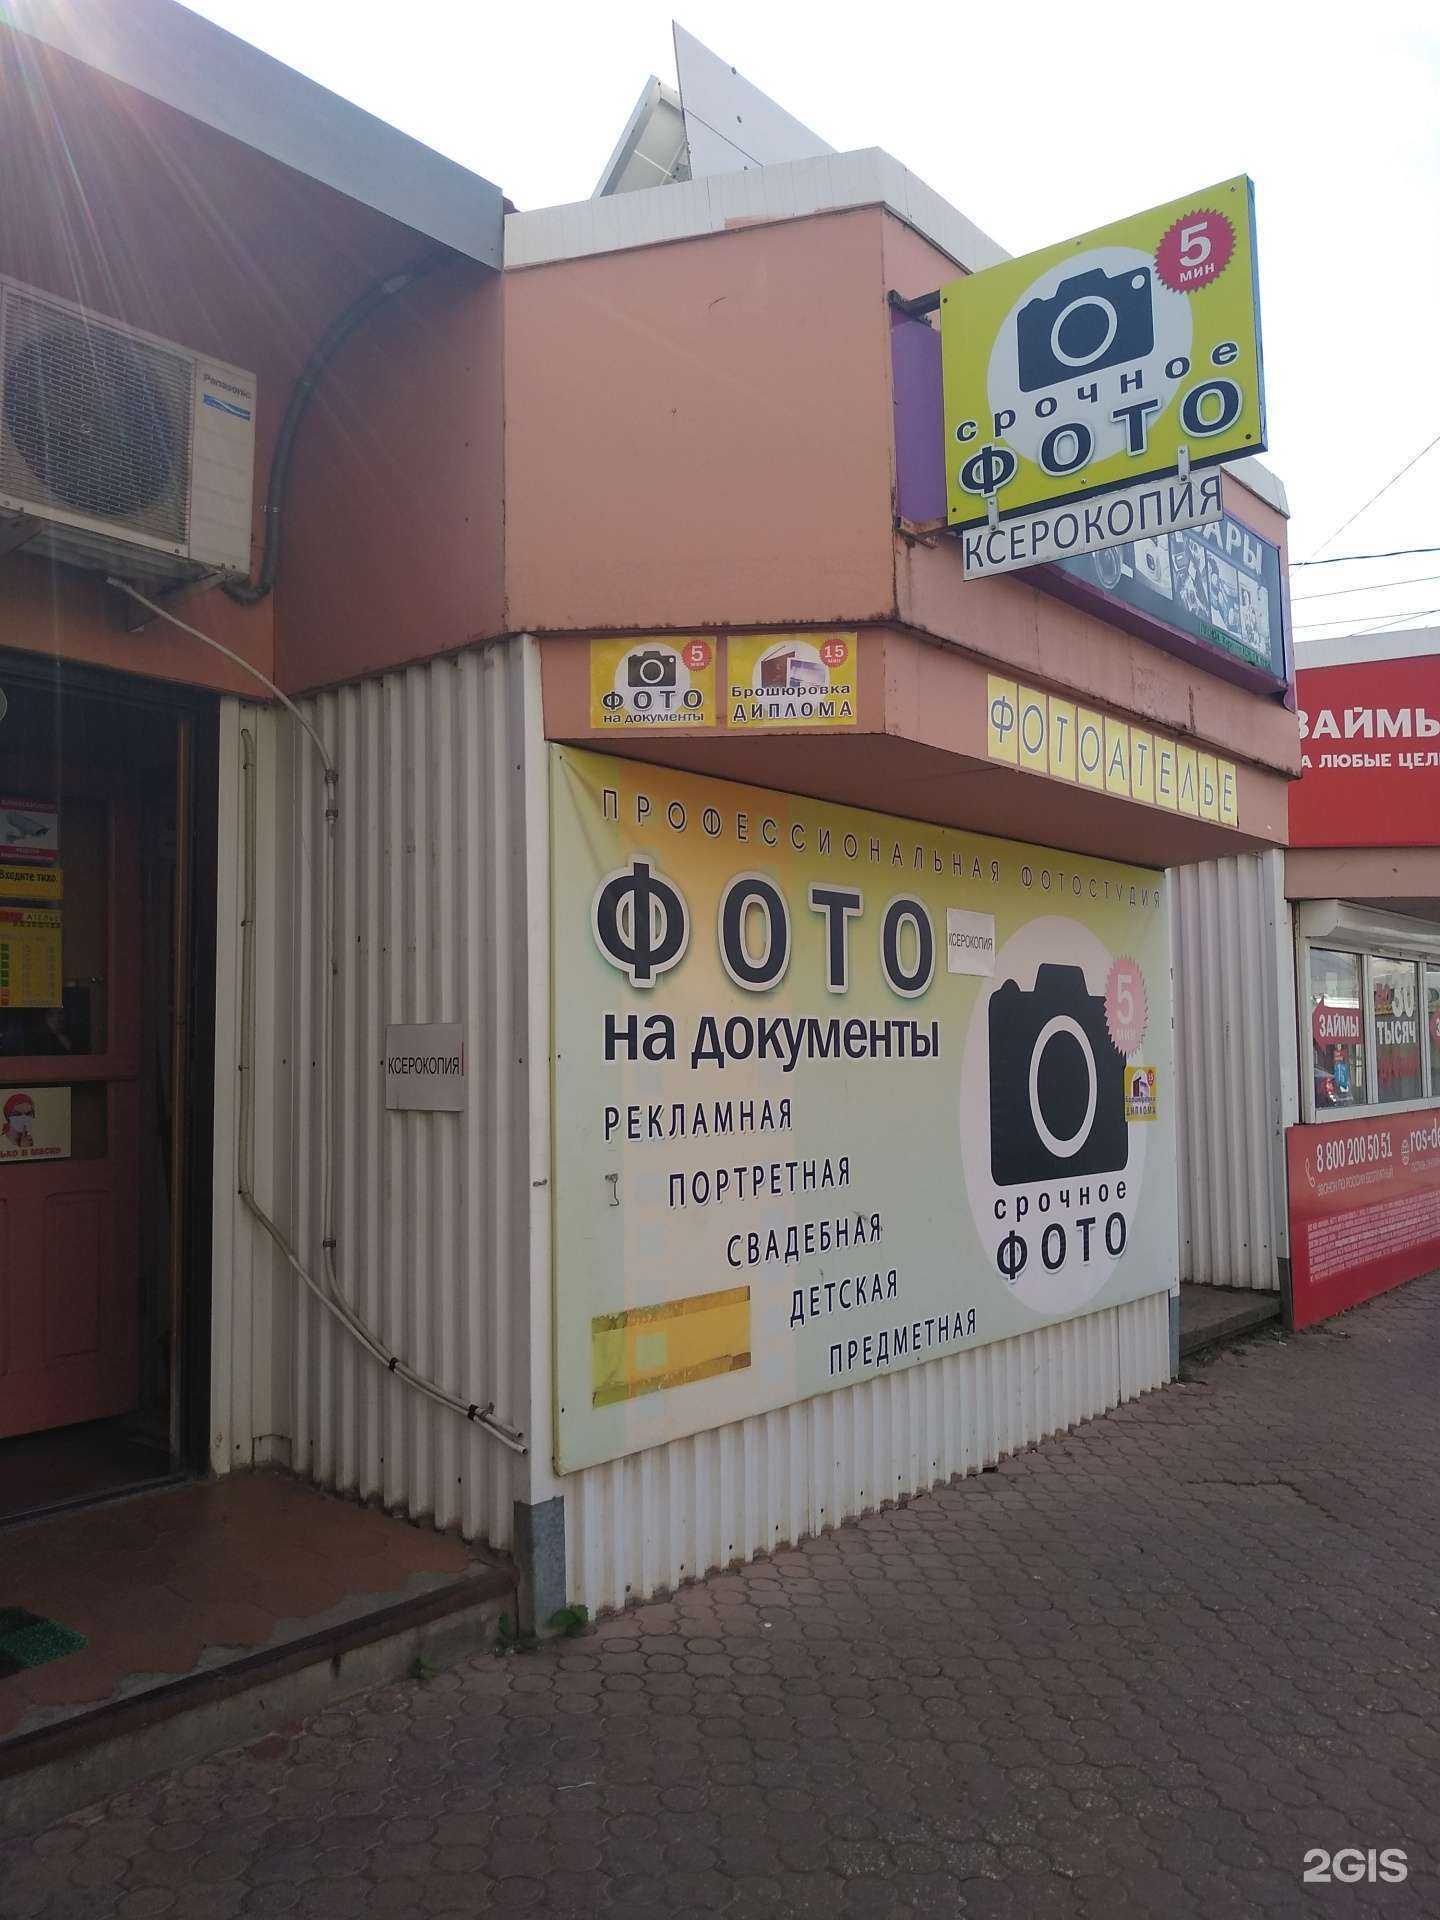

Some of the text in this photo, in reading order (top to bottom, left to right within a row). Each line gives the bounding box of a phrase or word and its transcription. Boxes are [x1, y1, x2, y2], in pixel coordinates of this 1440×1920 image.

[1179, 221, 1212, 268] 5
[956, 341, 1239, 443] срочное
[959, 379, 1242, 496] ФОТО
[965, 475, 1222, 571] КСЕРОКОПИЯ
[690, 646, 704, 662] 5
[824, 644, 844, 658] 15
[602, 688, 705, 711] ФОТО
[731, 684, 851, 701] Брошюровка
[733, 701, 852, 722] ДИПЛОМА
[604, 712, 705, 725] на документы
[991, 696, 1233, 813] ФОТОАТЕЛЬЕ
[1319, 753, 1392, 768] ЛЮБЫЕ
[1398, 752, 1440, 770] ЦЕЛ
[602, 788, 1161, 909] ПРОФЕССИОНАЛЬНАЯ ФОТОСТУДИЯ
[595, 859, 935, 995] ФОТО
[1116, 973, 1135, 1026] 5
[603, 1014, 940, 1073] на документы
[1319, 1013, 1360, 1038] ЗАЙМЫ
[1376, 1020, 1417, 1045] ТЫСЯЧ
[388, 1056, 460, 1075] КСЕРОКОПИЯ
[603, 1098, 793, 1142] РЕКЛАМНАЯ
[1316, 1131, 1393, 1173] 8 800 200 50 51
[668, 1157, 851, 1208] ПОРТРЕТНАЯ
[993, 1180, 1128, 1221] срочное
[727, 1213, 882, 1267] СВАДЕБНАЯ
[995, 1212, 1128, 1280] ФОТО
[789, 1270, 899, 1327] ДЕТСКАЯ
[829, 1308, 978, 1375] ПРЕДМЕТНАЯ
